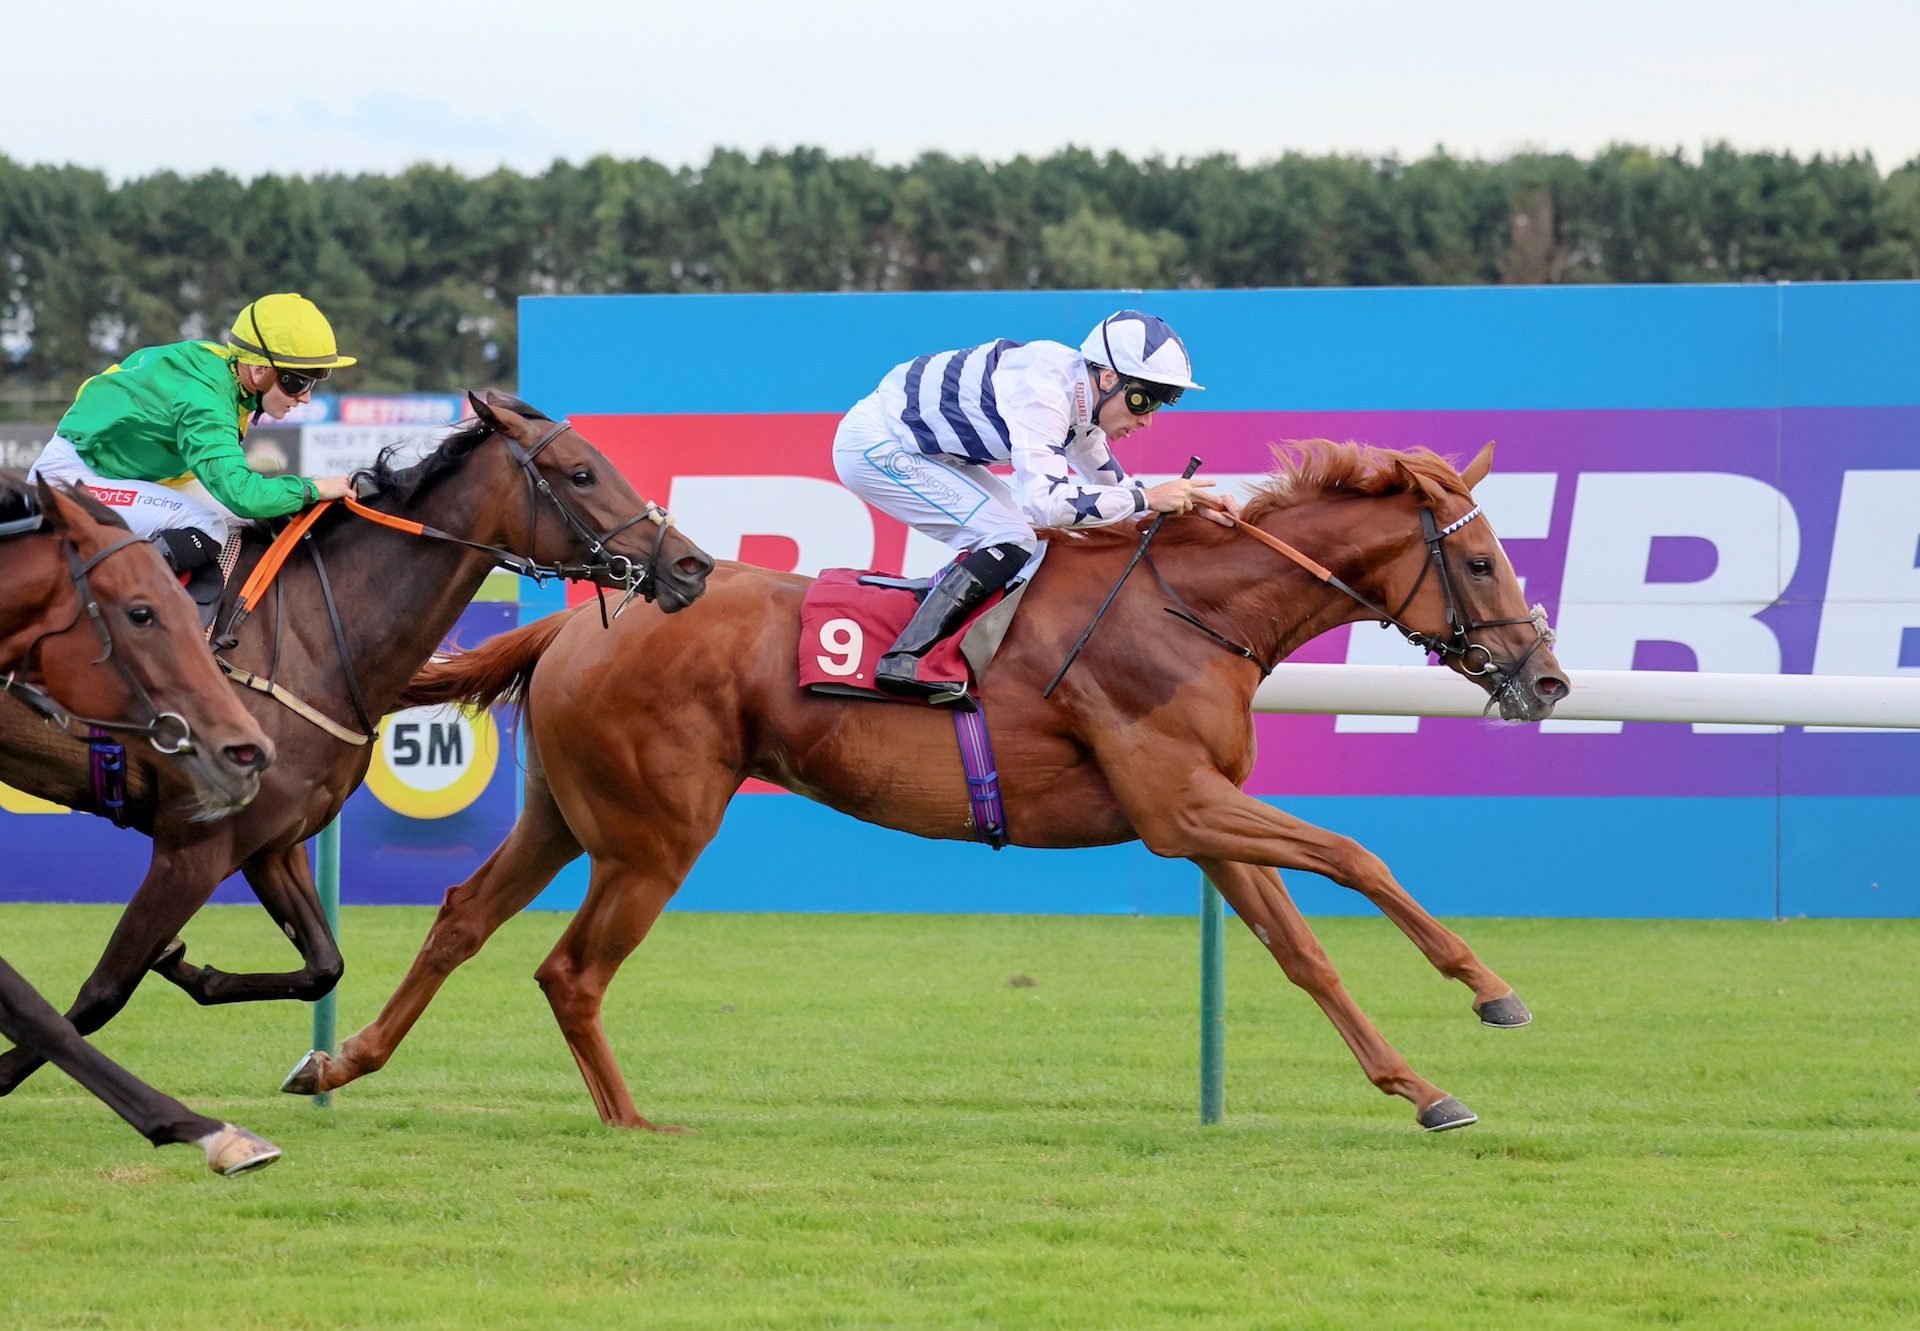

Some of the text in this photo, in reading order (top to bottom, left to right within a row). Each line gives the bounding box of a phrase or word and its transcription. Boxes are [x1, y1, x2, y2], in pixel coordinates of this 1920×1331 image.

[1076, 382, 1088, 423] FITZDARES
[137, 494, 183, 511] racing
[393, 723, 463, 767] 5M
